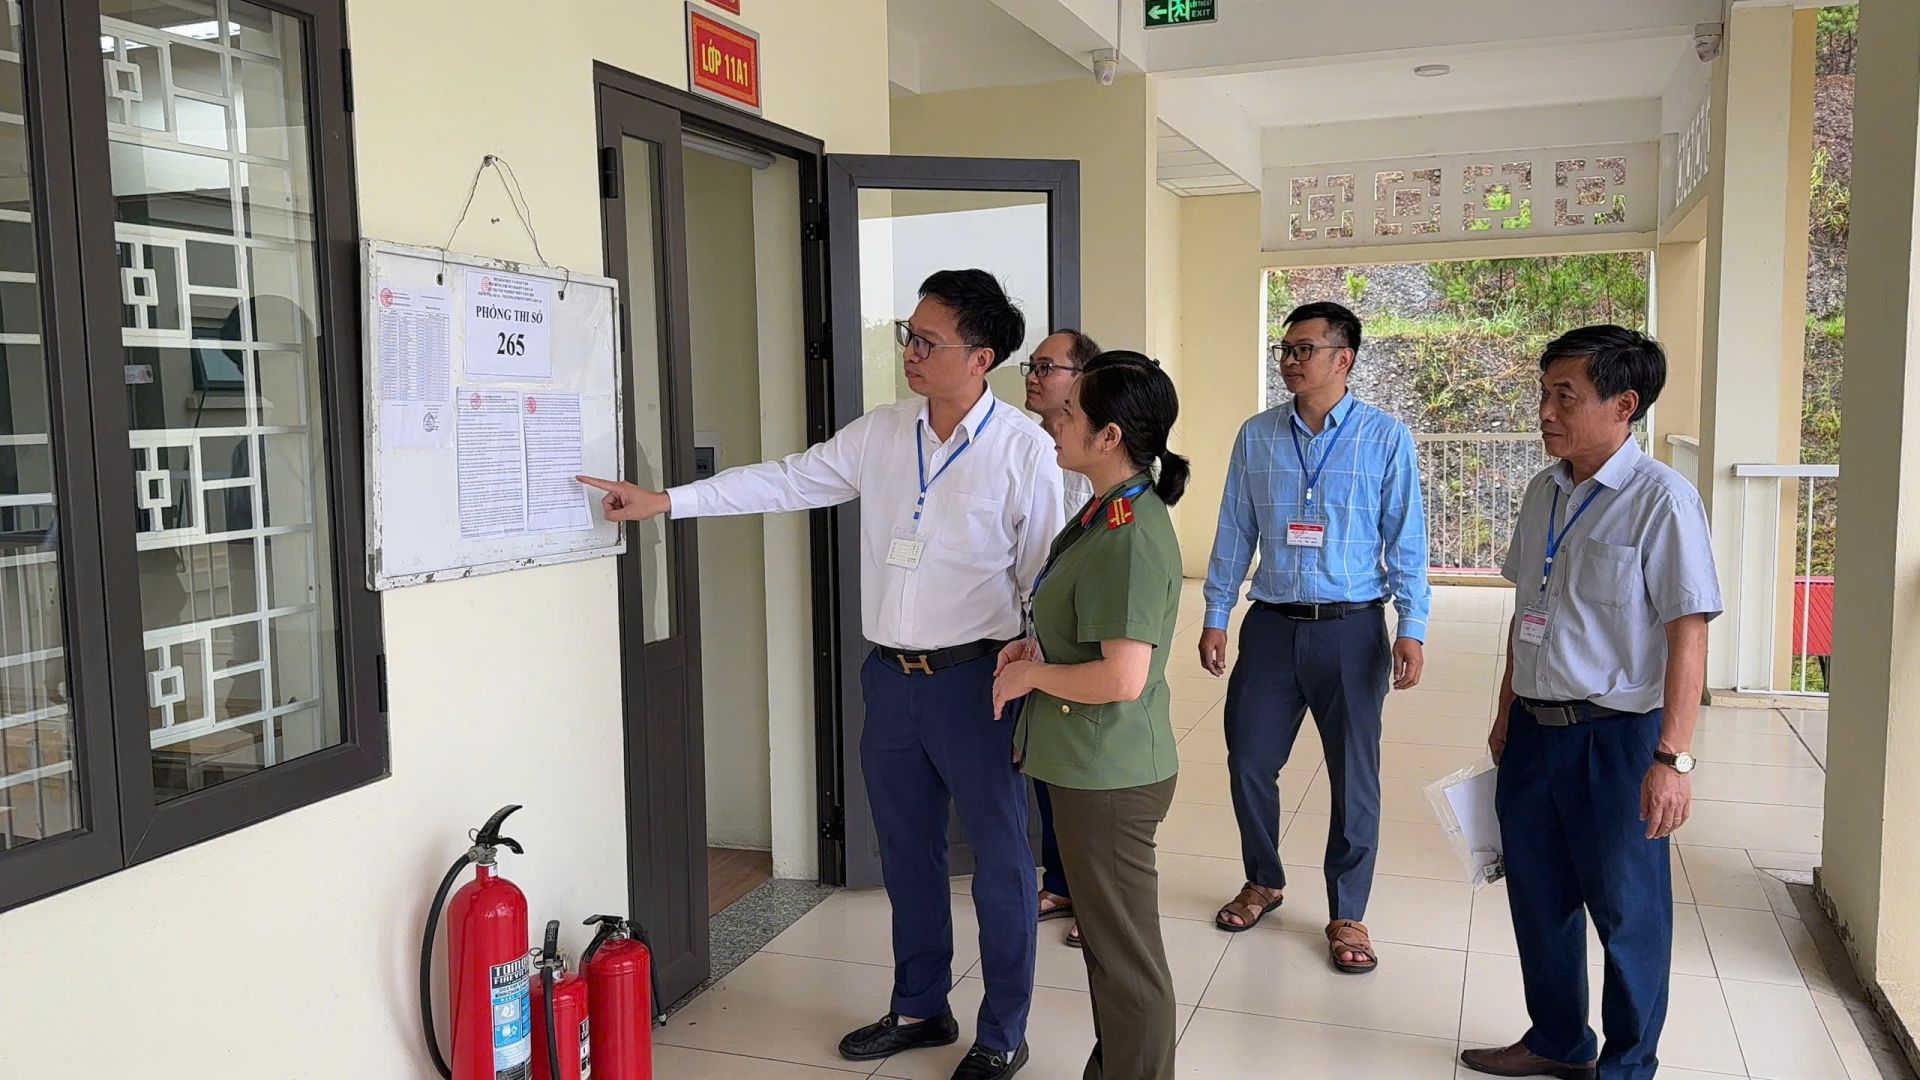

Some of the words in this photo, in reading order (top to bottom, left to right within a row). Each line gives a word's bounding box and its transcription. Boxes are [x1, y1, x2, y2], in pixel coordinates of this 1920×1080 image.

[1191, 8, 1211, 17] EXIT
[702, 39, 721, 75] LỚP
[725, 54, 748, 87] 11A1
[476, 304, 512, 321] PHÒNG
[514, 310, 530, 323] THI
[497, 332, 525, 356] 265
